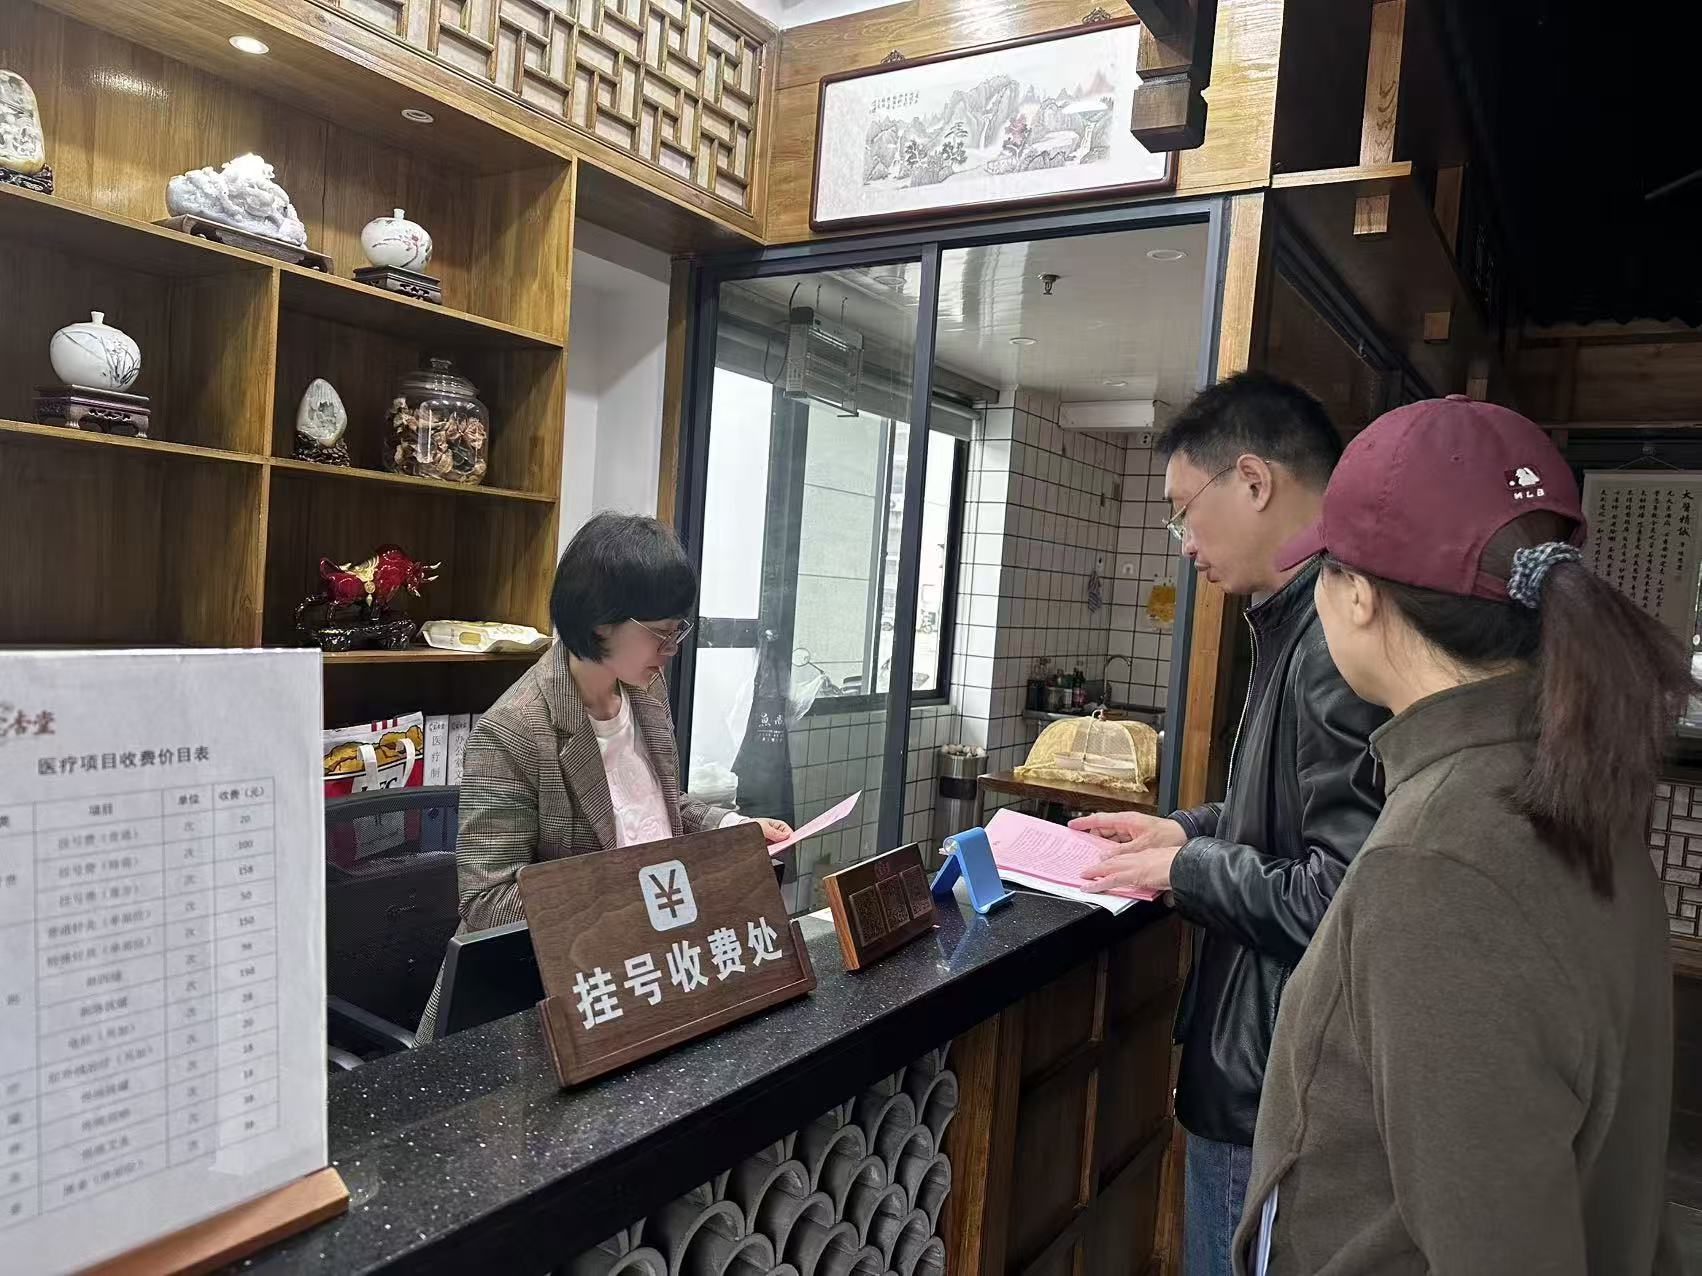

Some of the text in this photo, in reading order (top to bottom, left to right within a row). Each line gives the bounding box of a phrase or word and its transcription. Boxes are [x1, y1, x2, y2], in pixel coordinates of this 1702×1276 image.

[1513, 488, 1545, 500] MLB
[38, 745, 211, 776] 医疗项目收费价目表
[430, 735, 441, 785] 医疗制
[88, 803, 114, 817] 项目
[572, 916, 783, 1030] 挂号收费处
